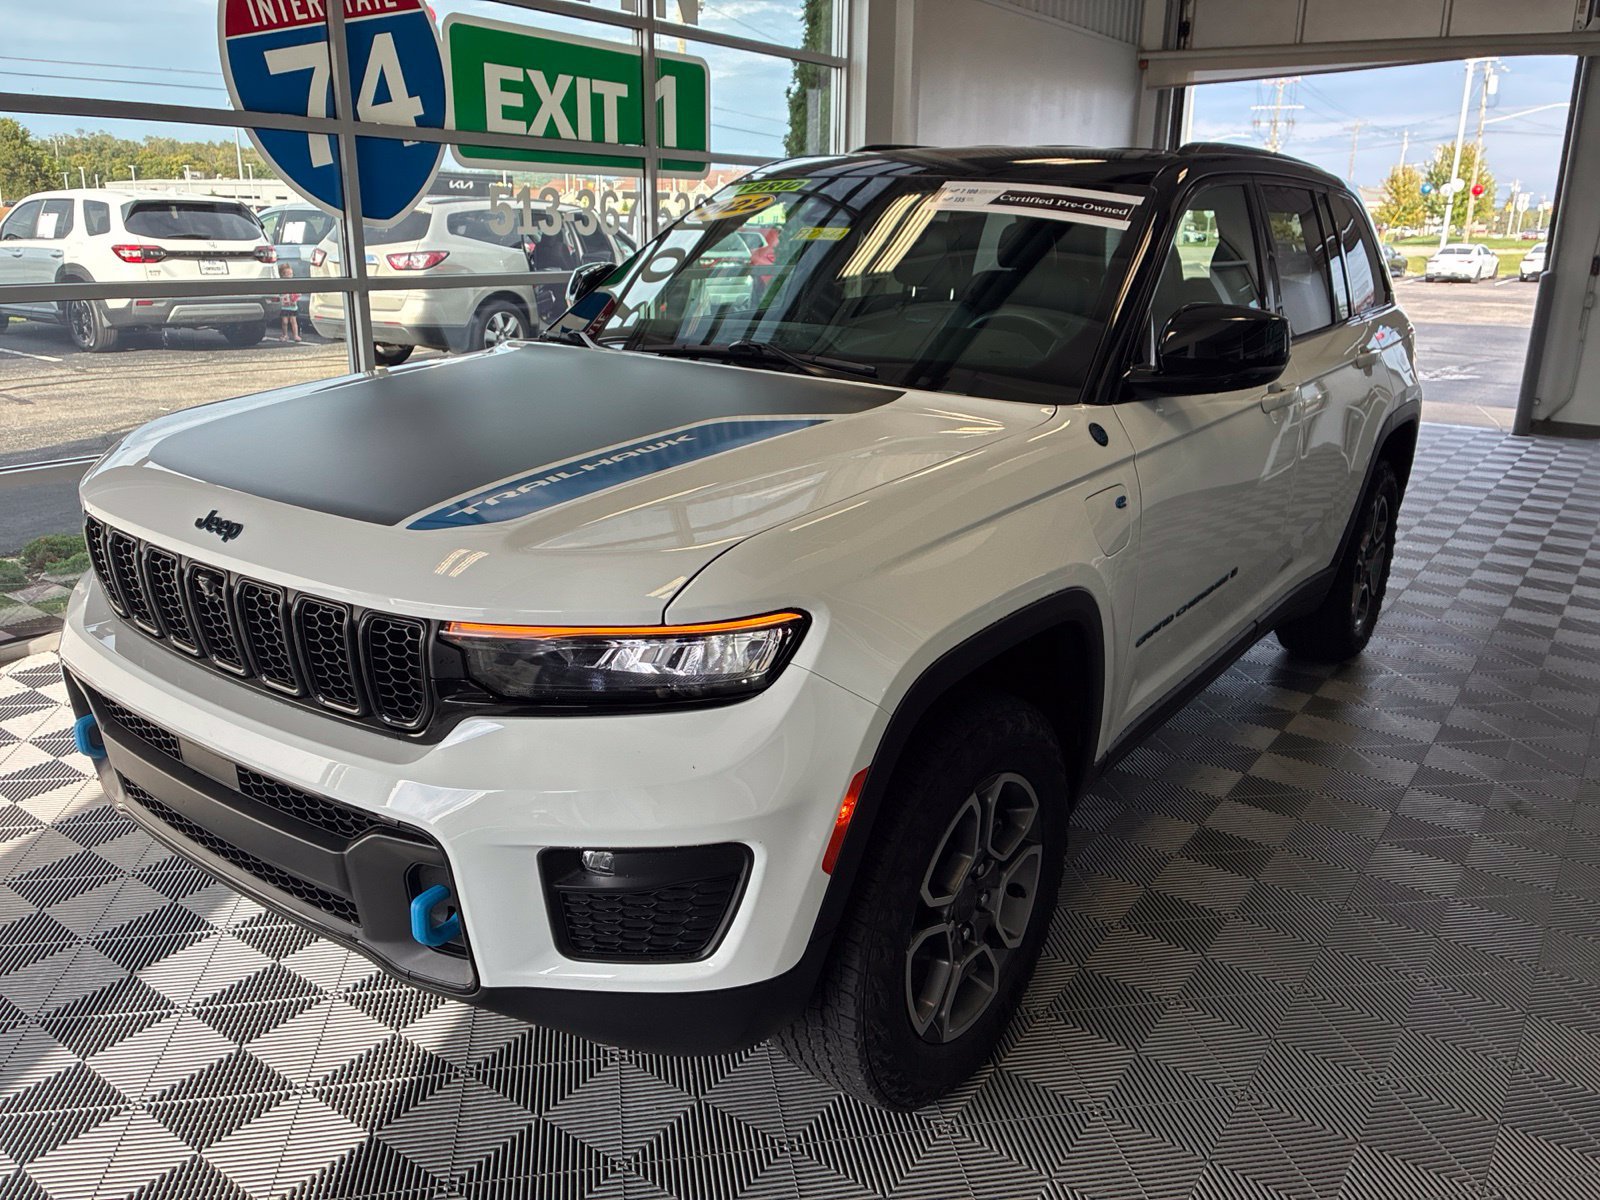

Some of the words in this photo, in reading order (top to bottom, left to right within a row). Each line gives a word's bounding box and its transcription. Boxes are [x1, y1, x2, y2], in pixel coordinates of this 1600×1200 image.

[263, 32, 425, 168] 74
[483, 62, 628, 144] EXIT
[654, 74, 678, 148] 1
[999, 193, 1054, 206] Certified
[1056, 198, 1129, 217] Pre-Owned
[446, 434, 697, 517] TRAILHAWK
[194, 509, 244, 543] Jeep
